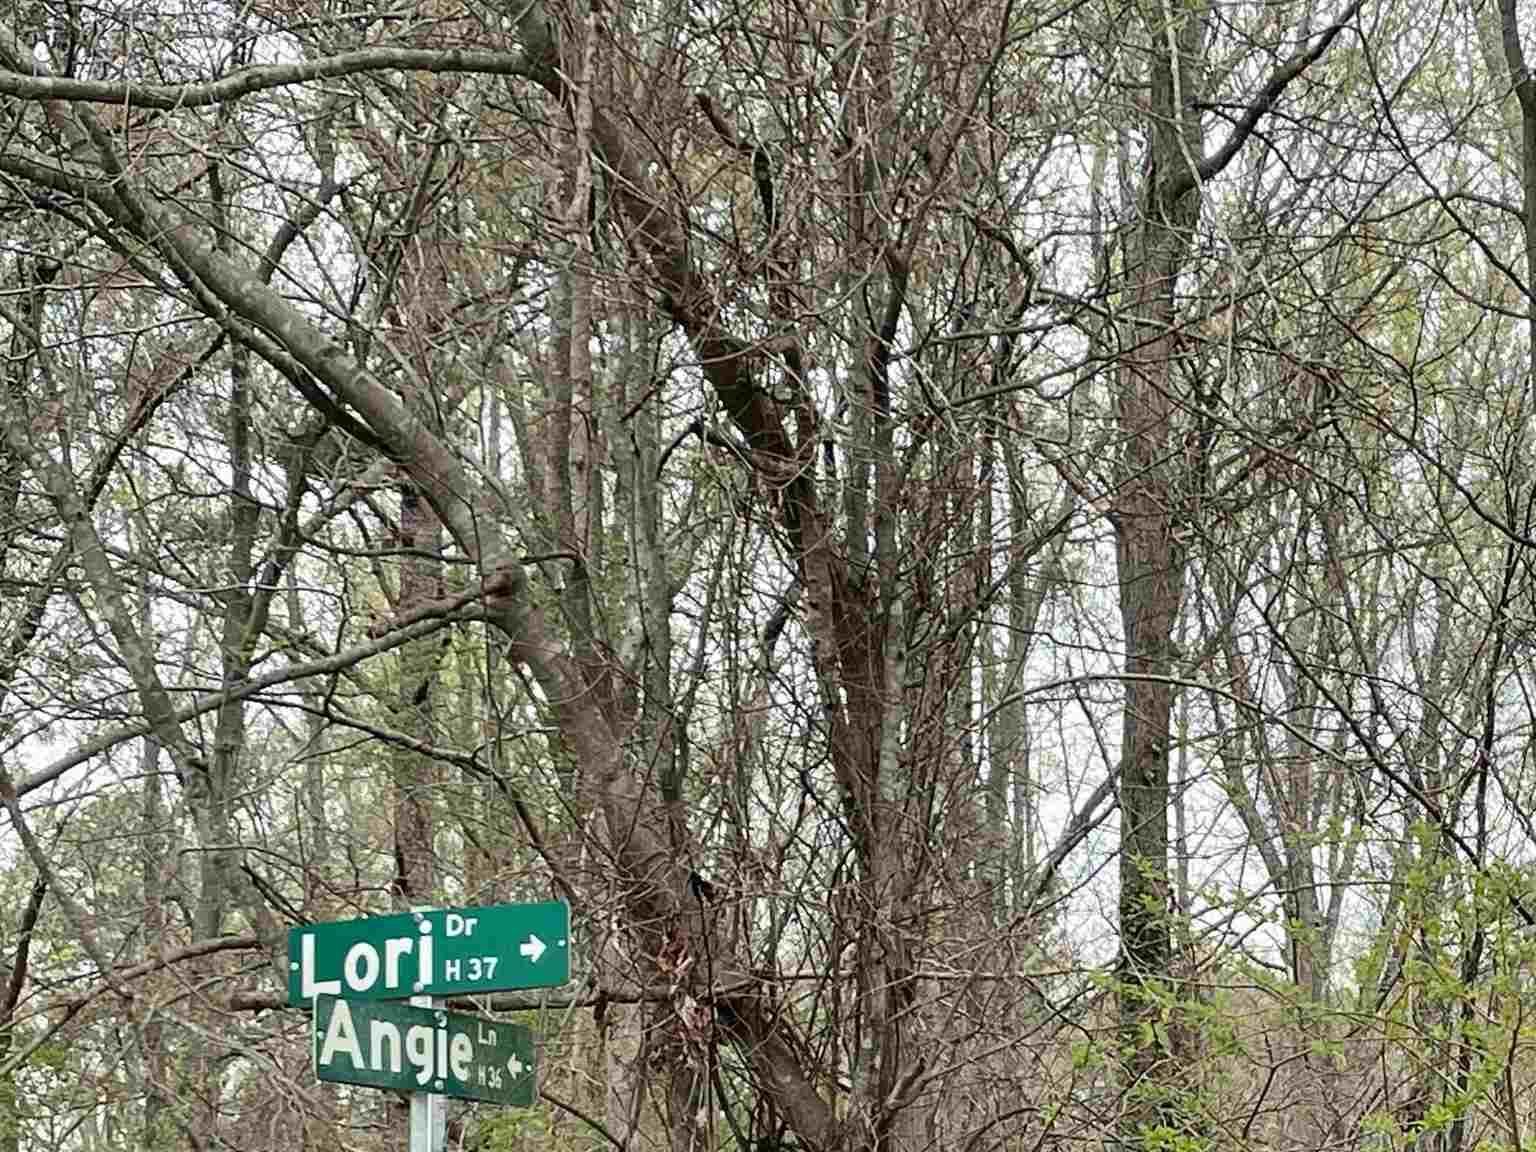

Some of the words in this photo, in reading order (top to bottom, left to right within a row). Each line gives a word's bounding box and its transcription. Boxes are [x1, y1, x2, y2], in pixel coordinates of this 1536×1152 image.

[302, 919, 433, 997] Lori
[445, 914, 478, 936] Dr
[445, 959, 461, 981] H
[467, 957, 498, 981] 37
[319, 999, 473, 1086] Angie
[478, 1022, 497, 1046] Ln
